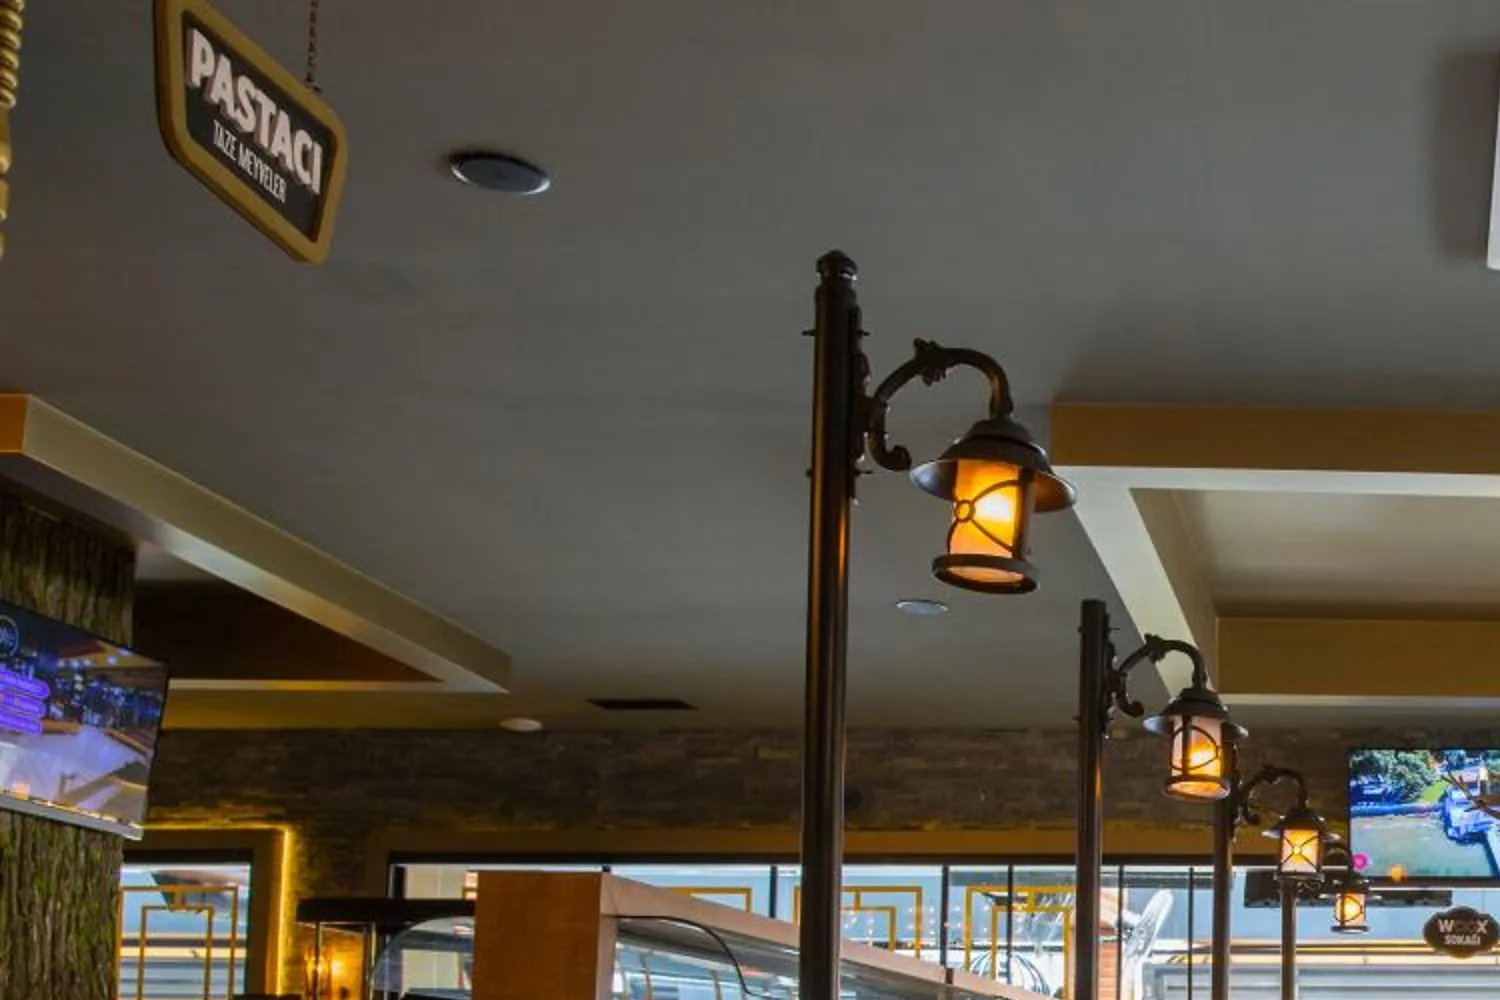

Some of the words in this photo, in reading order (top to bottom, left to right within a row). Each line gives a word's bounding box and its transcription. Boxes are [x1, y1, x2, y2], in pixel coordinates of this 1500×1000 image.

[186, 28, 324, 195] PASTACI
[213, 119, 238, 162] TAZE
[238, 142, 288, 204] MEYVELER
